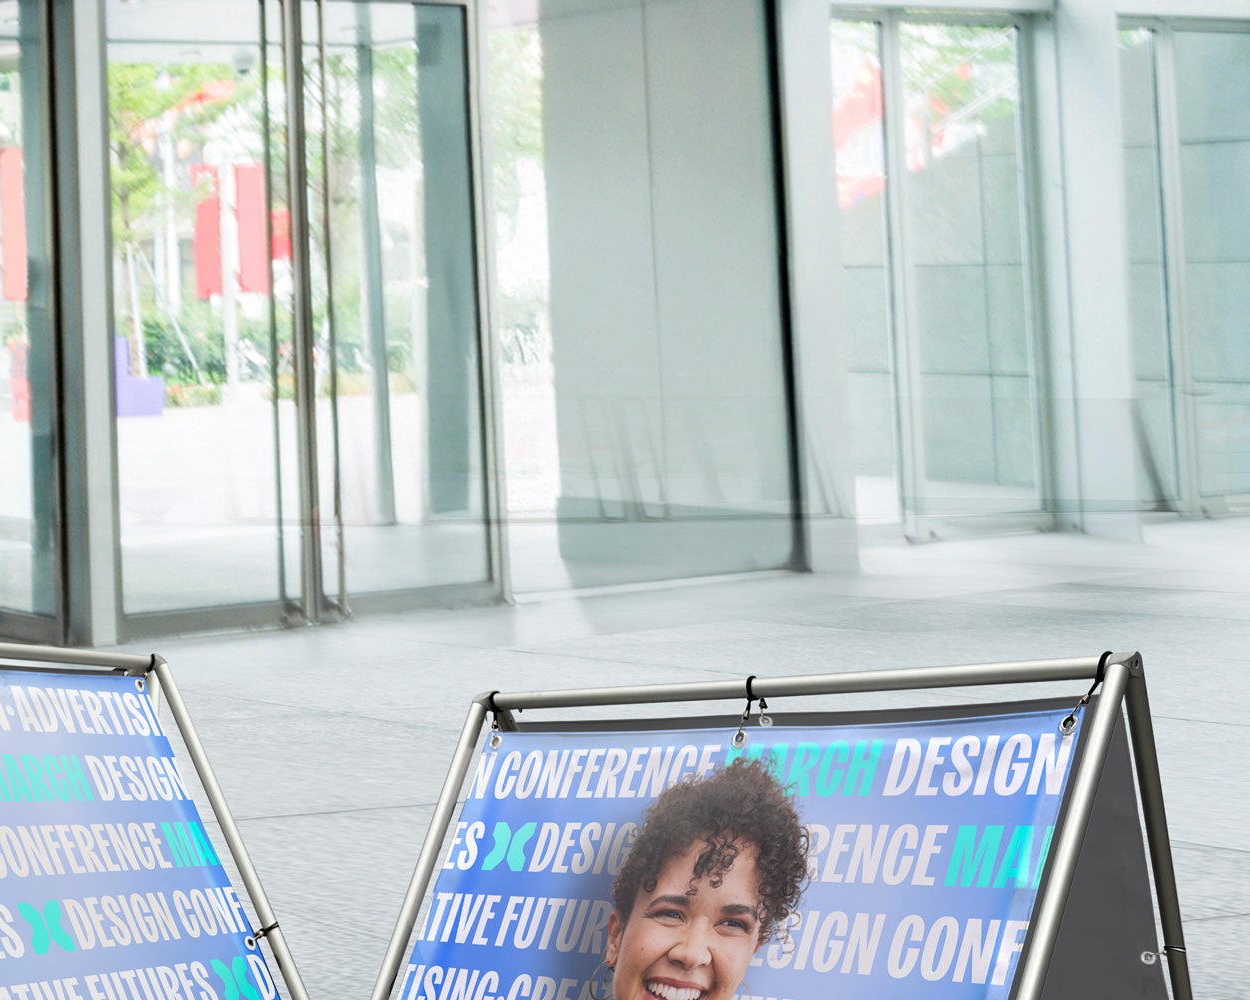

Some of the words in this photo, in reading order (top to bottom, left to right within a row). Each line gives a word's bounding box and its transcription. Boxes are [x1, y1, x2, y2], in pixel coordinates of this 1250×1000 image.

[89, 755, 192, 801] DESIGN
[724, 739, 885, 797] ARCH
[882, 732, 1075, 797] DESIGN
[160, 822, 221, 868] MA
[62, 891, 182, 950] DESIGN
[172, 886, 247, 938] CONF
[417, 892, 502, 946] TIVE
[749, 910, 887, 976] SIGN
[887, 914, 1031, 987] CONF
